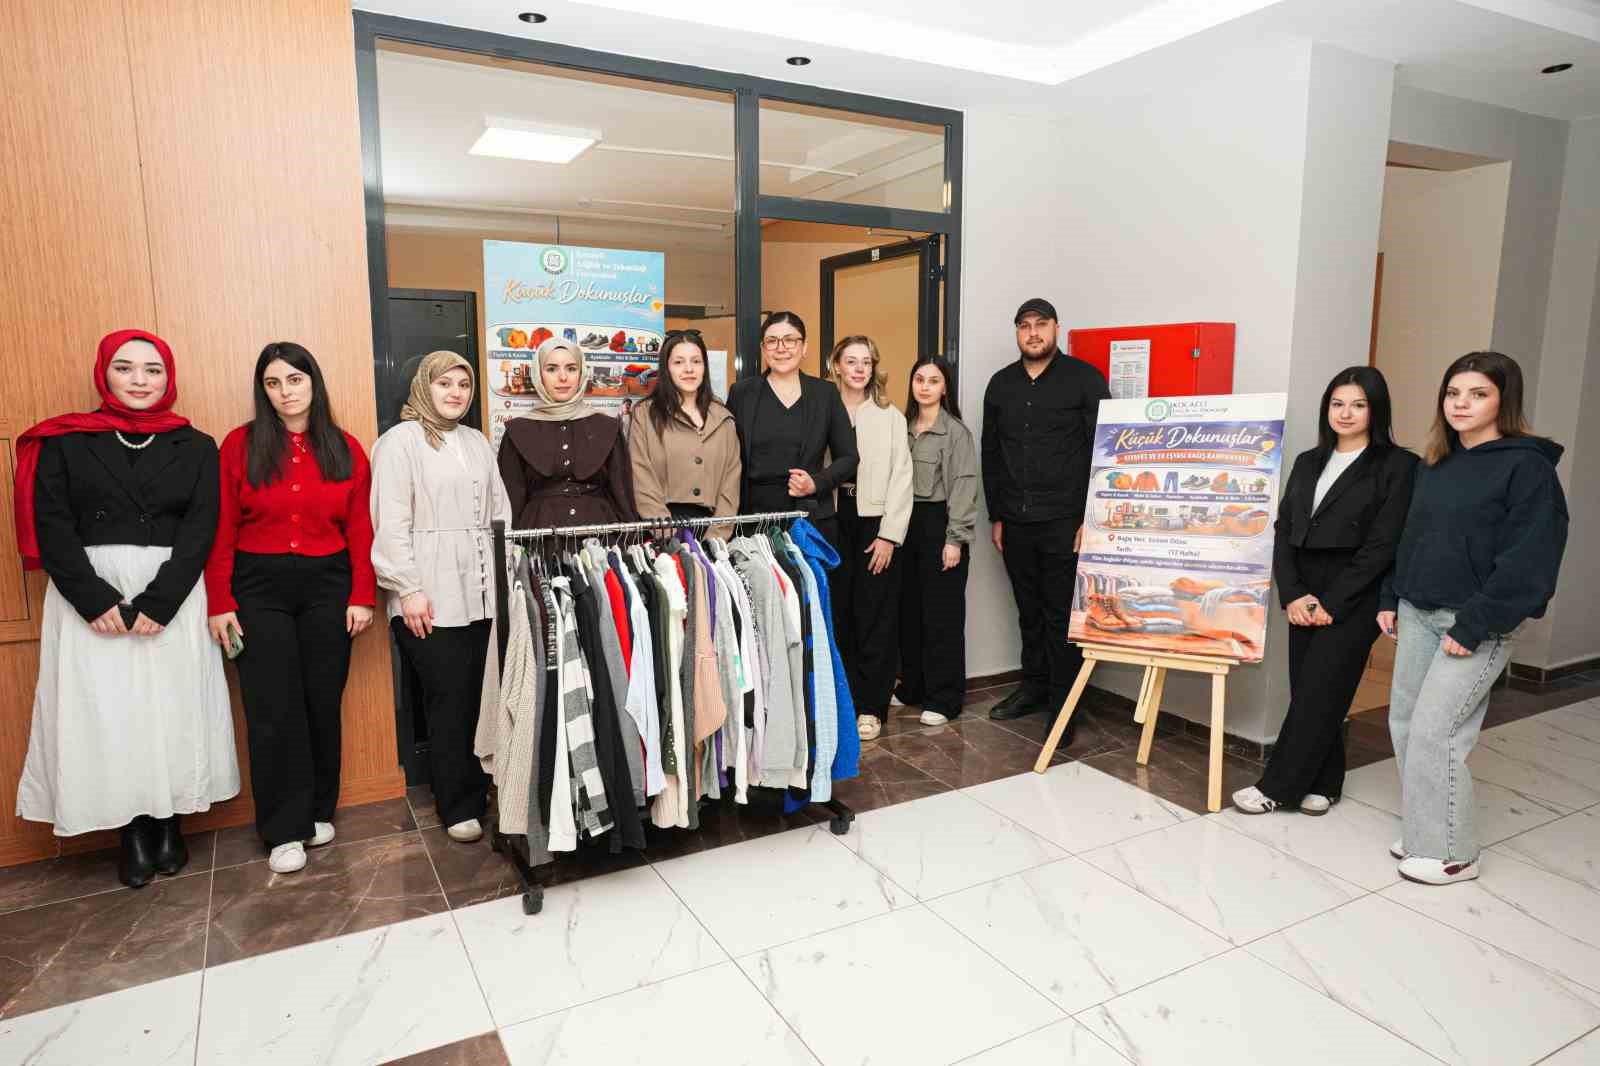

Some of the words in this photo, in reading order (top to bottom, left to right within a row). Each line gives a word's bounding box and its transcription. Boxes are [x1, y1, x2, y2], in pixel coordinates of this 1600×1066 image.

[504, 279, 554, 304] Küçük
[560, 280, 652, 305] Dokunuşlar
[1114, 428, 1165, 450] Küçük
[1166, 426, 1263, 448] Dokunuşlar
